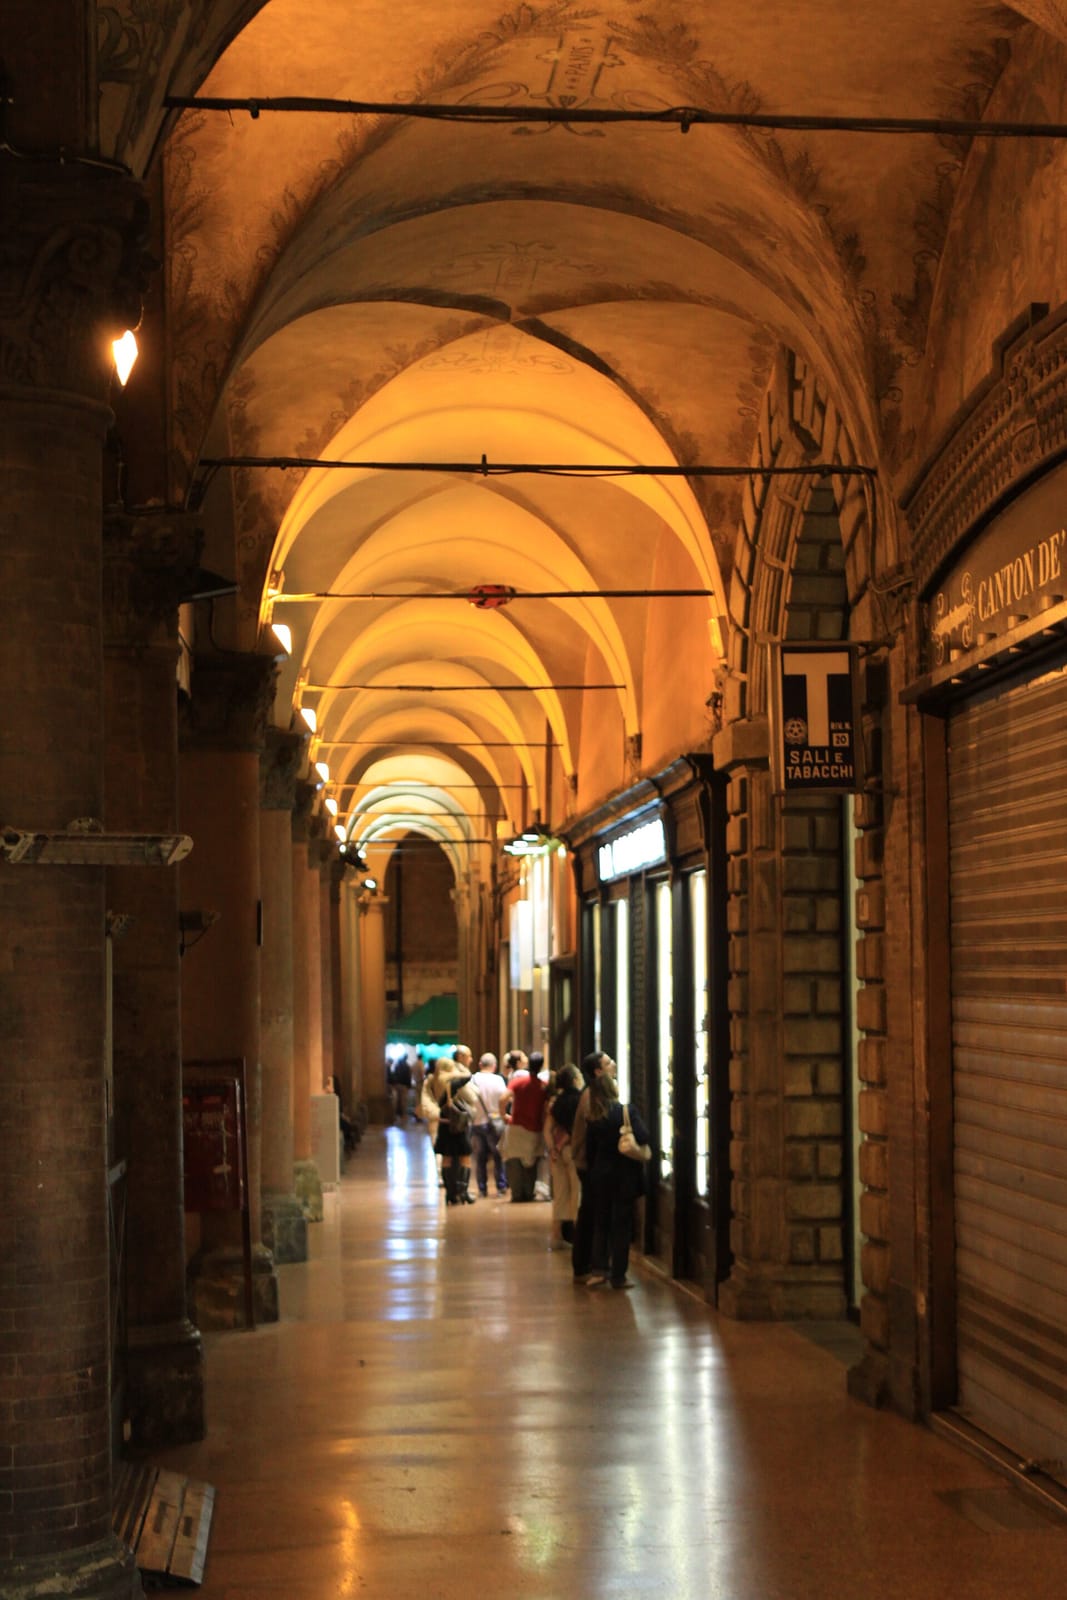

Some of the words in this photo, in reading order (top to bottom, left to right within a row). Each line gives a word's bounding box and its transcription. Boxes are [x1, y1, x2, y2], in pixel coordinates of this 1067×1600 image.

[978, 549, 1035, 620] CANTON
[783, 652, 849, 747] T
[786, 766, 853, 779] TABACCHI
[790, 750, 829, 764] SALI
[834, 752, 843, 763] E
